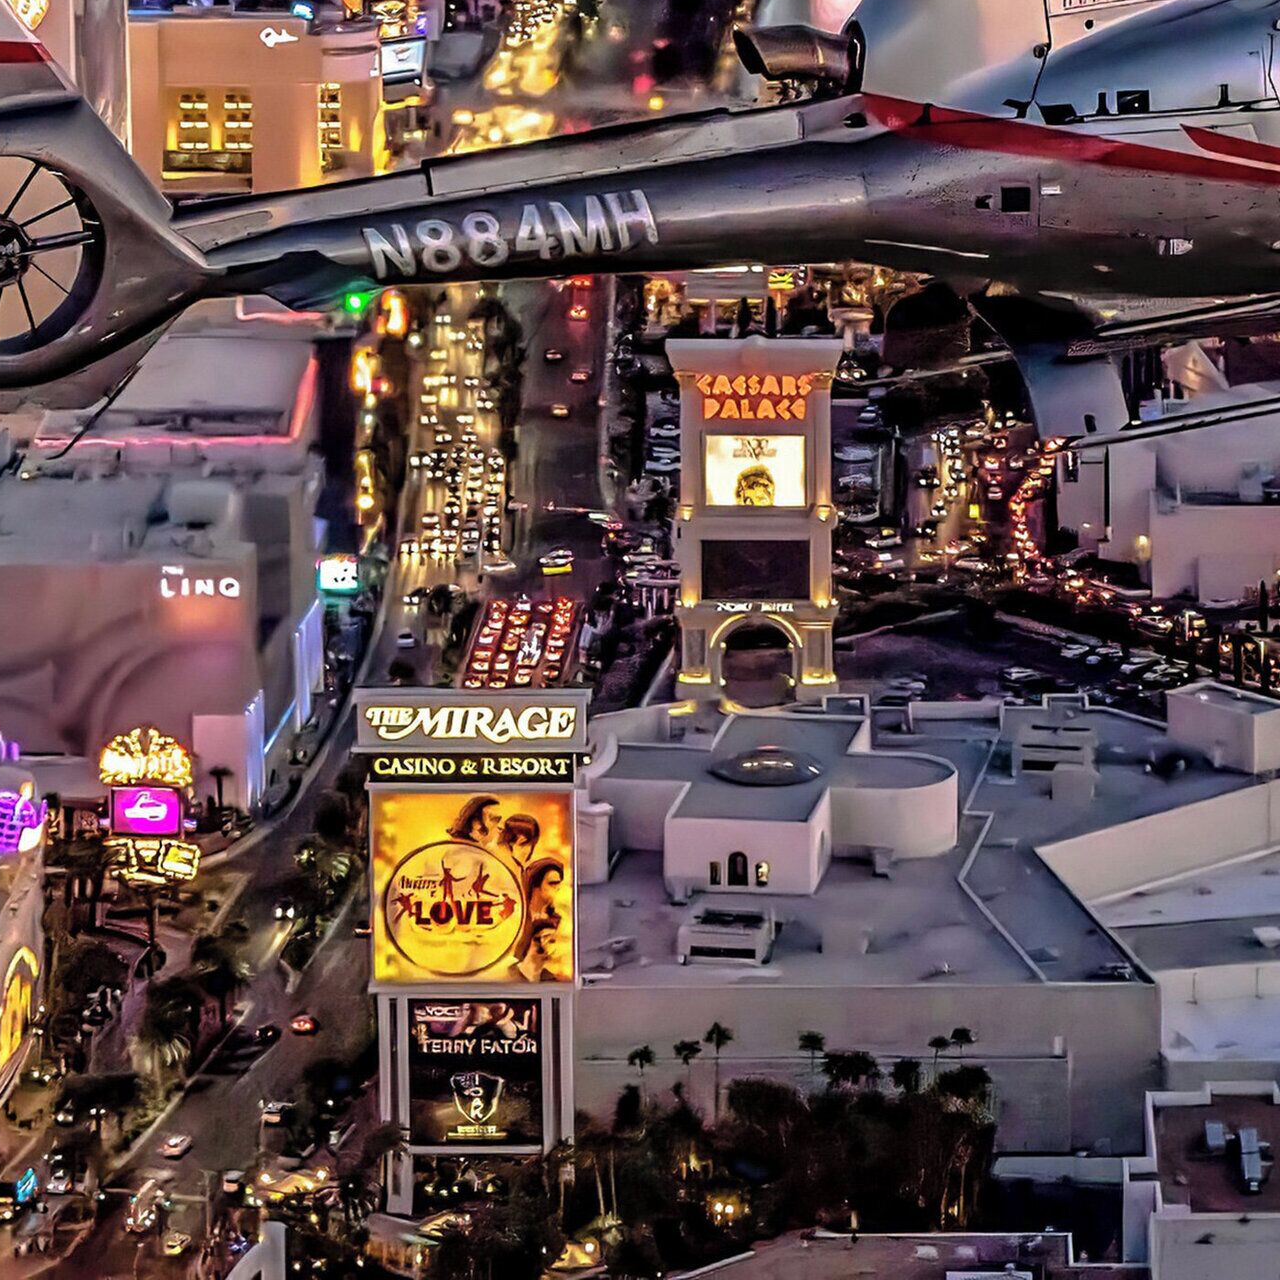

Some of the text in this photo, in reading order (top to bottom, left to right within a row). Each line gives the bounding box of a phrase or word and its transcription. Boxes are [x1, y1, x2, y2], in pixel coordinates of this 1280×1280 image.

[361, 188, 659, 280] N884MH
[696, 373, 813, 397] CAESARS
[703, 397, 806, 421] PALACE
[160, 577, 240, 599] LINQ
[365, 705, 577, 744] THE MIRAGE
[373, 757, 571, 777] CASINO & RESORT
[414, 899, 494, 926] LOVE
[422, 1038, 538, 1055] TERRY FATOR
